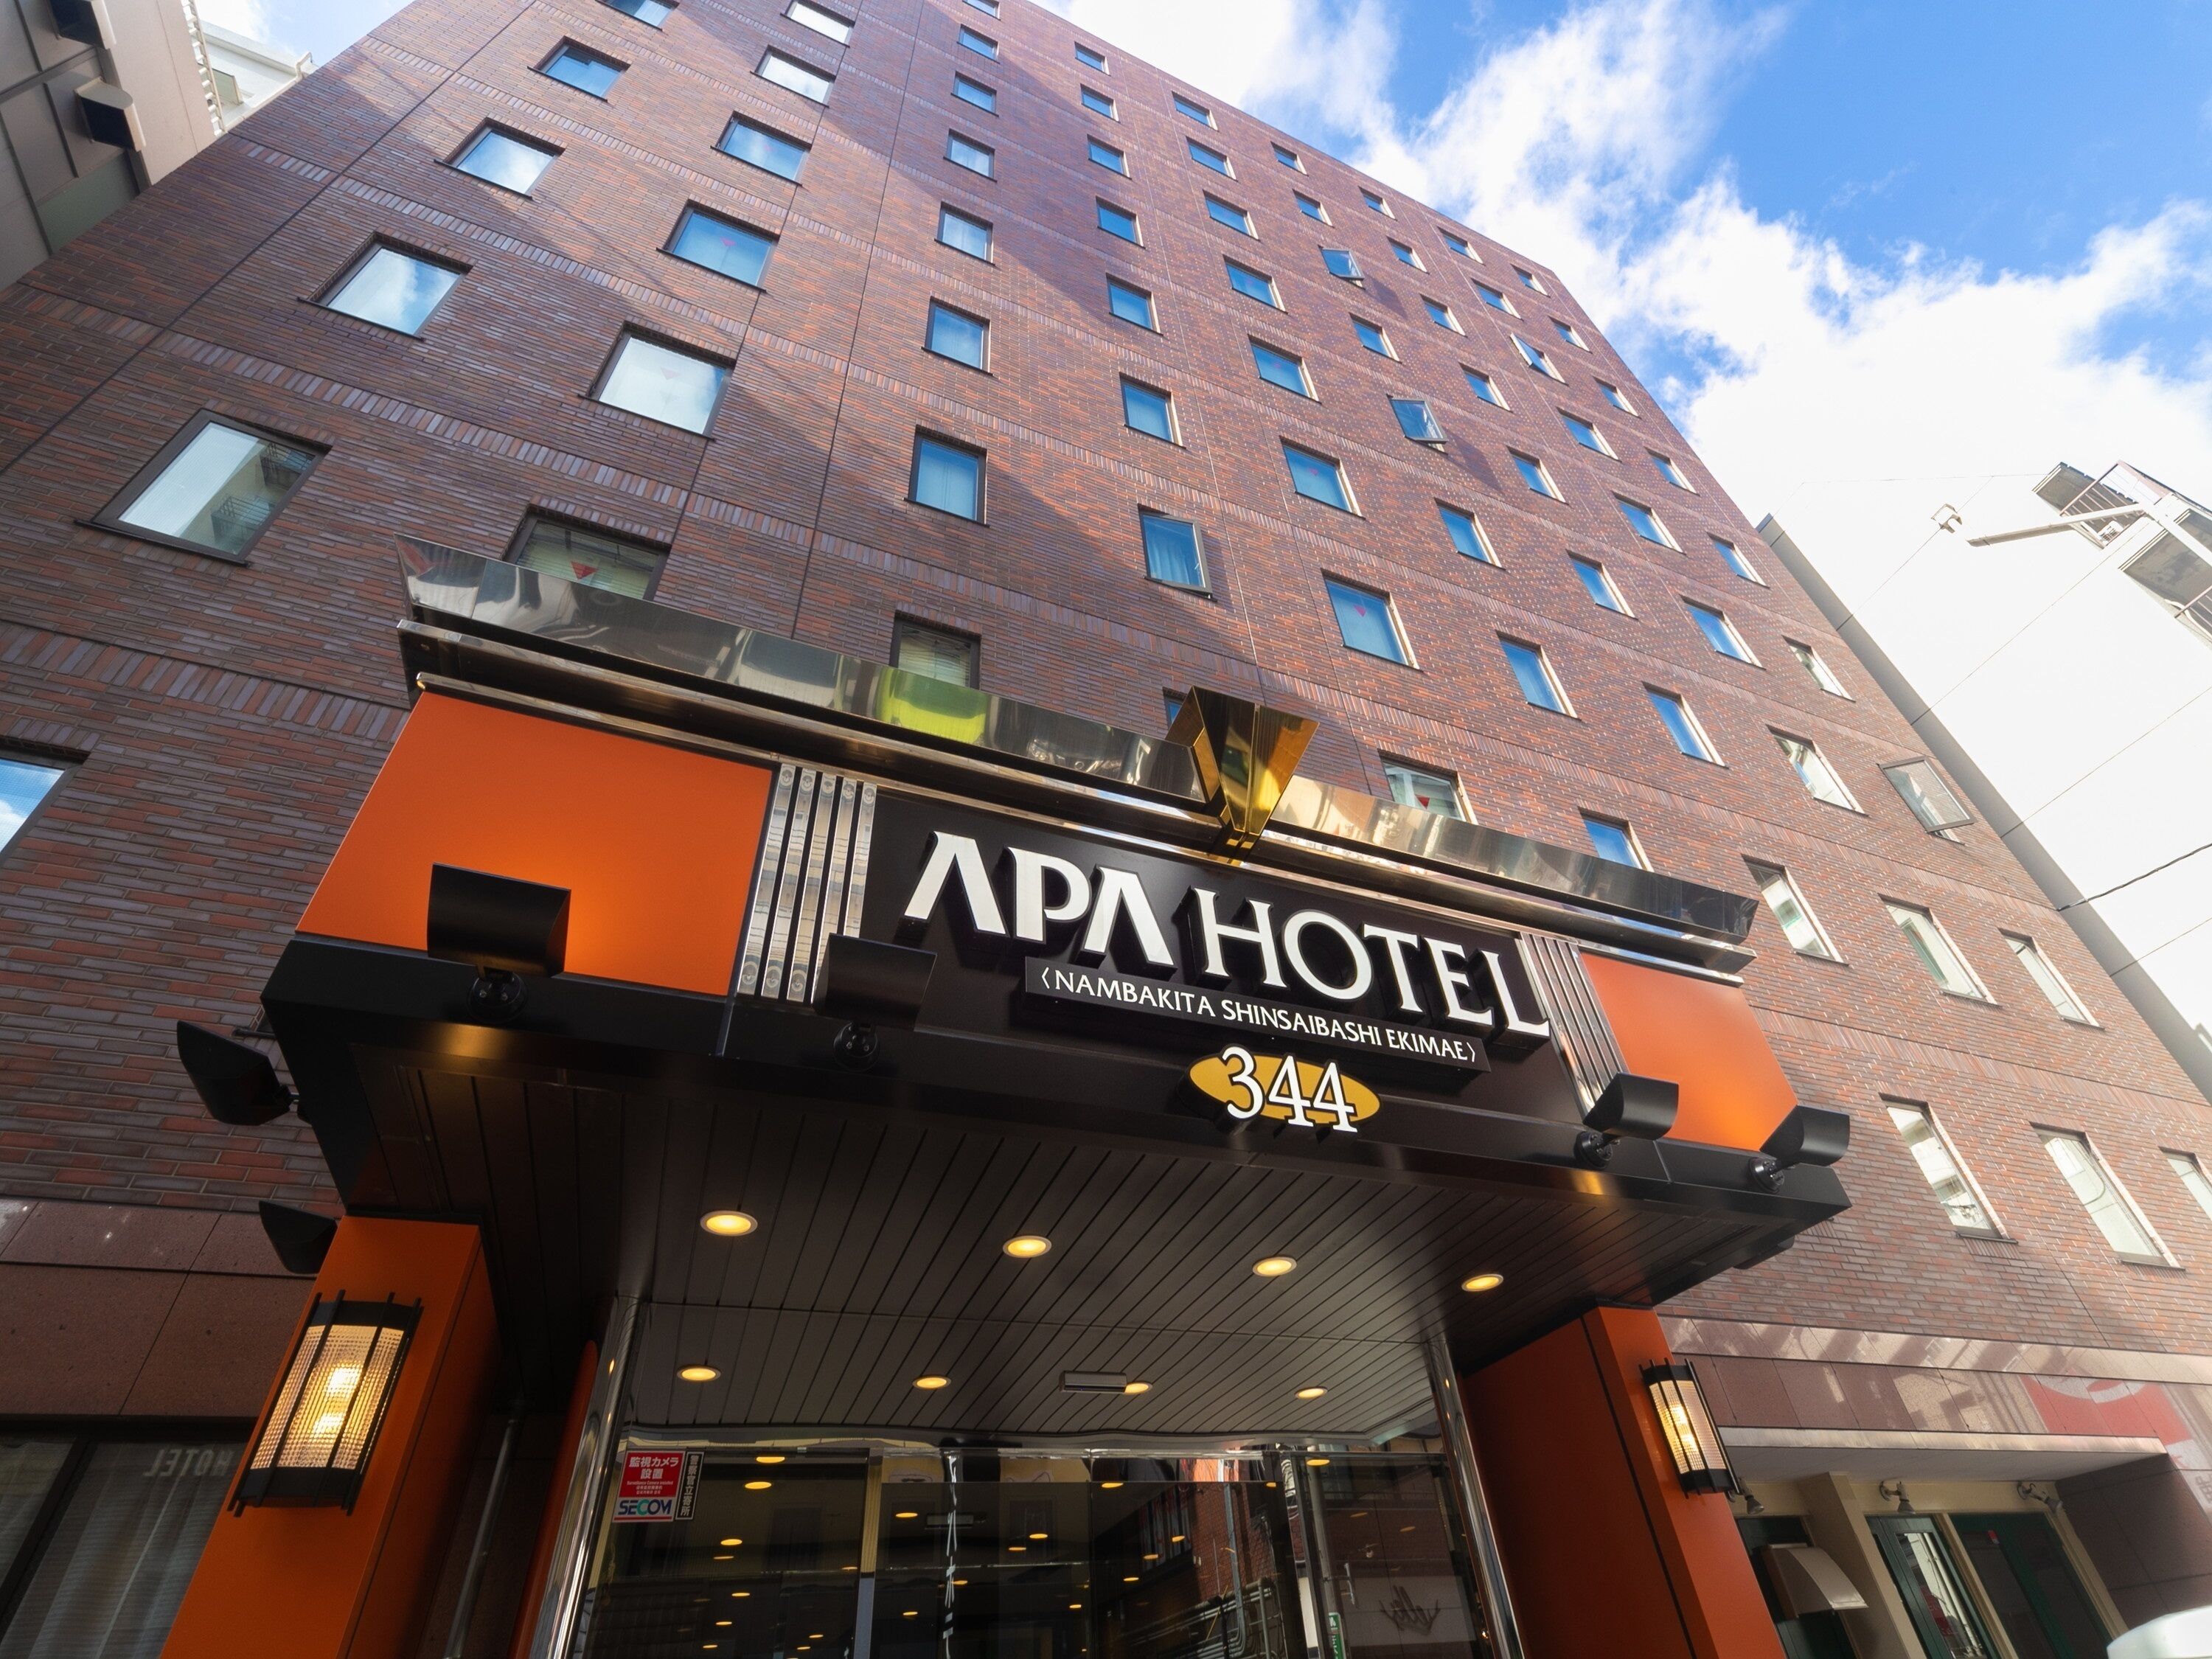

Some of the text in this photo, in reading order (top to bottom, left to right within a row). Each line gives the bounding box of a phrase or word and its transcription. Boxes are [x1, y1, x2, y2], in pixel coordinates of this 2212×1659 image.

[904, 831, 1550, 1037] APA HOTEL
[1221, 999, 1382, 1046] SHINSAIBASHI
[1222, 1046, 1358, 1133] 344
[628, 1456, 679, 1468] 監視カメラ
[640, 1469, 664, 1479] 設置
[618, 1499, 672, 1516] SECOM
[680, 1455, 700, 1517] 警察官立寄所
